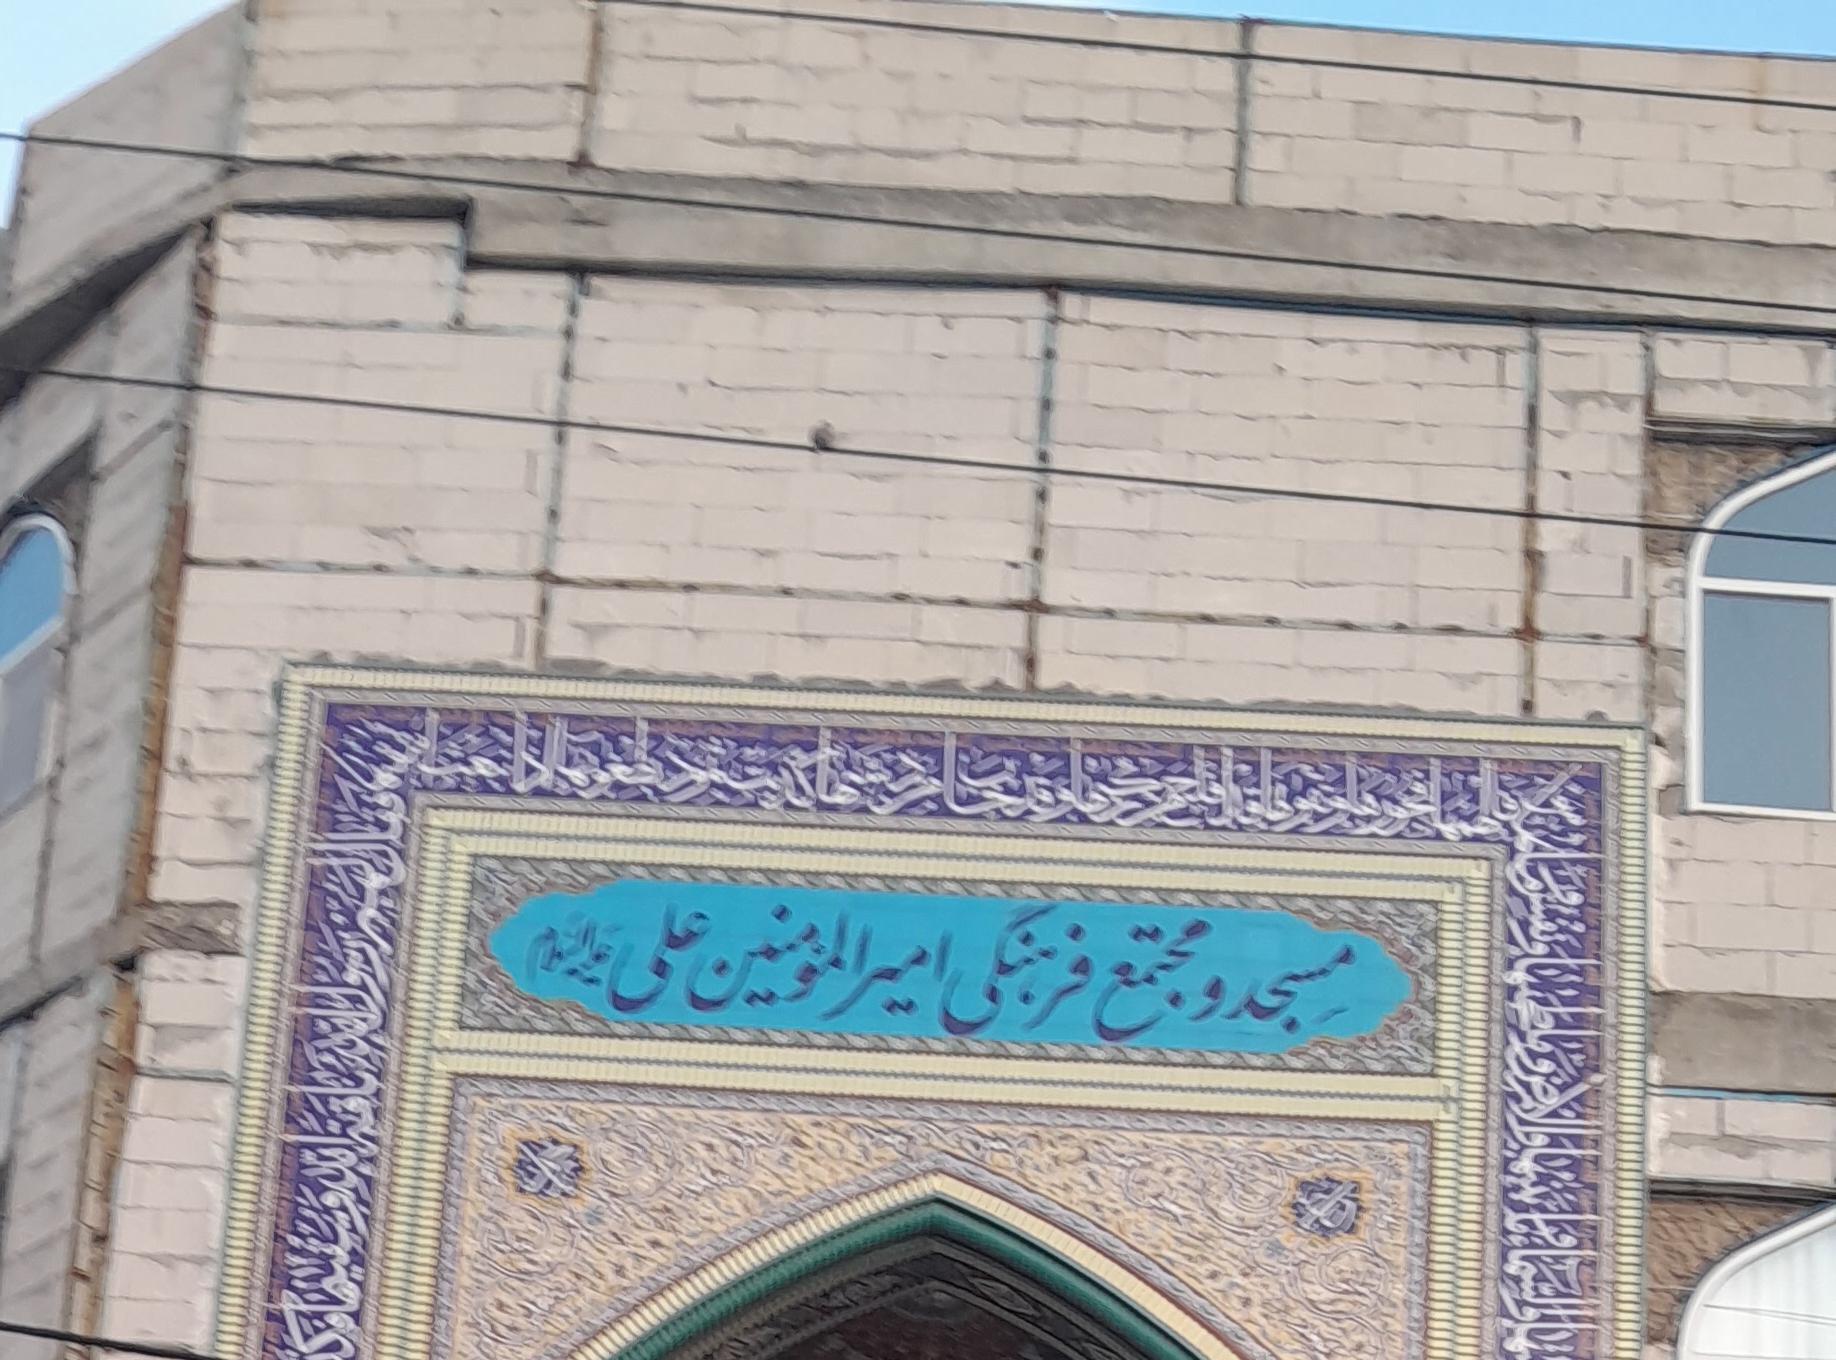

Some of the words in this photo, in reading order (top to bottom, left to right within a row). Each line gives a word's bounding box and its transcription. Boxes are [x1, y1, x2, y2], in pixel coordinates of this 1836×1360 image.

[605, 901, 710, 1014] علی
[1092, 917, 1211, 1042] مجتمع
[1221, 942, 1356, 1034] مسجد
